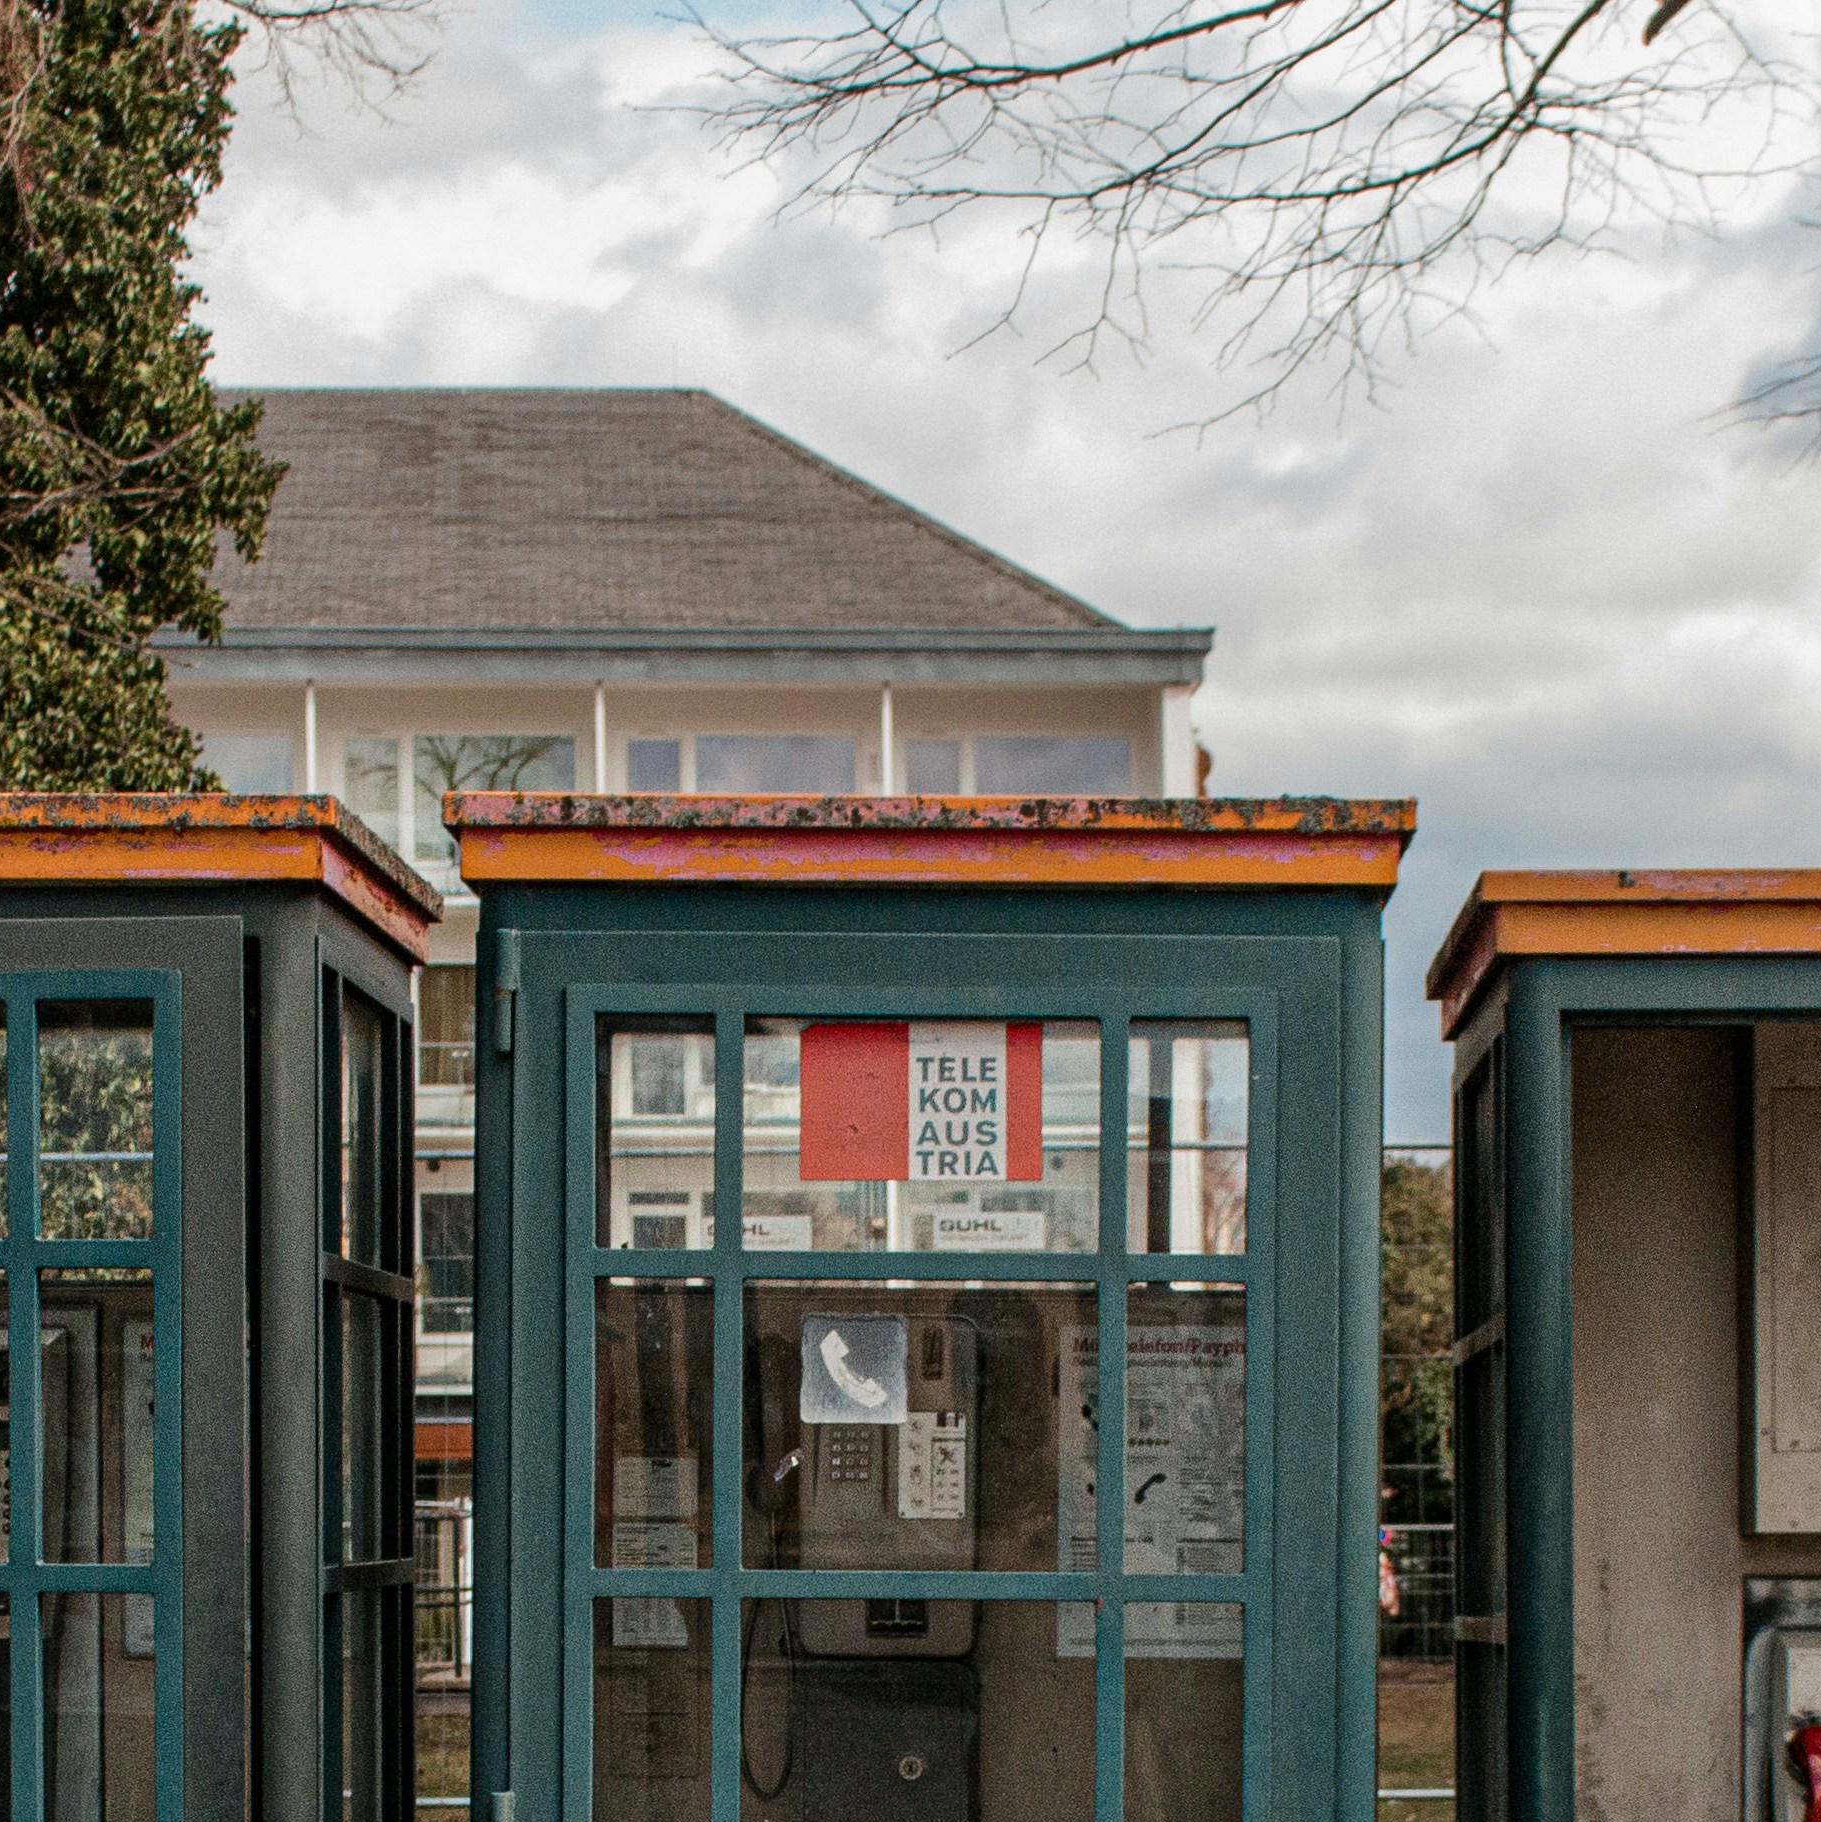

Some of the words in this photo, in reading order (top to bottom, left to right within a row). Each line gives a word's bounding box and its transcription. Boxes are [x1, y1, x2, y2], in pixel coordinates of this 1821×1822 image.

[916, 1057, 997, 1082] TELE
[919, 1088, 997, 1113] KOM
[917, 1120, 998, 1146] AUS
[916, 1150, 999, 1175] TRIA
